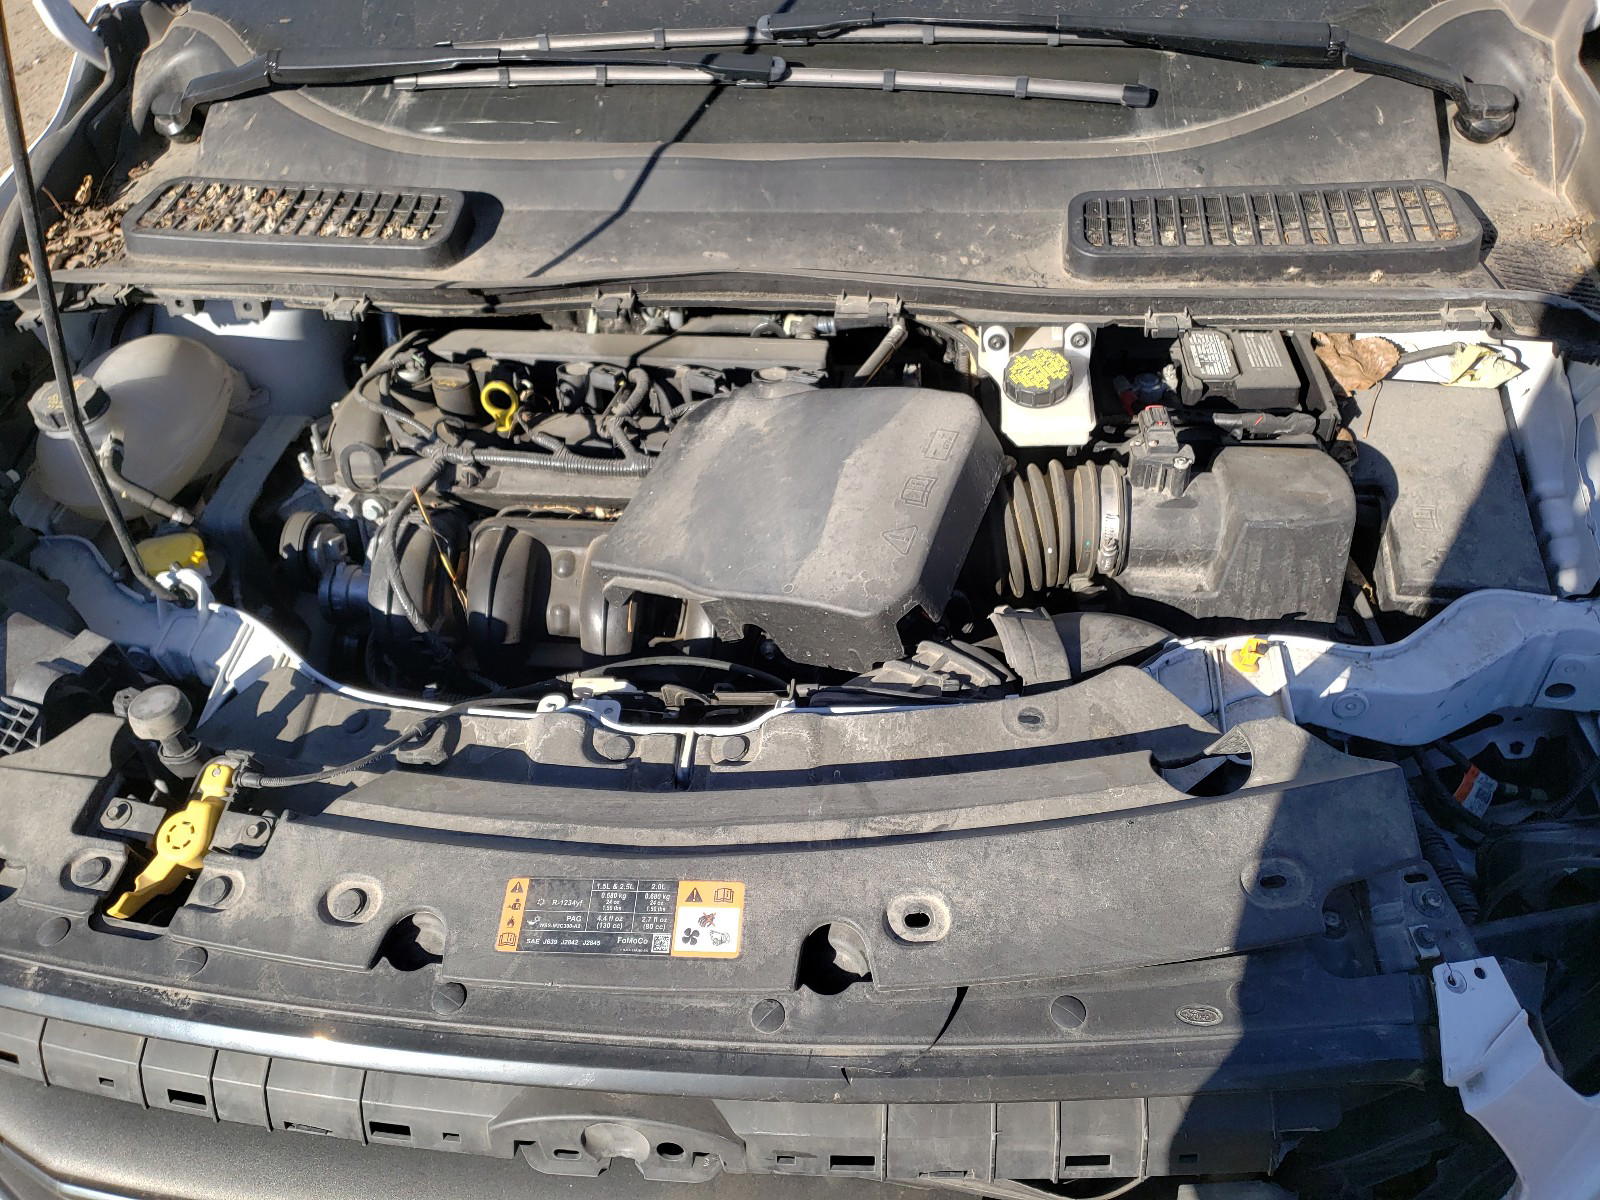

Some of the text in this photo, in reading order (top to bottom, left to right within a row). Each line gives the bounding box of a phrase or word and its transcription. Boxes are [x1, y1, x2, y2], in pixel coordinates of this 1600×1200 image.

[552, 900, 584, 908] R-1234yf
[612, 922, 623, 930] cc)
[655, 924, 666, 932] cc)
